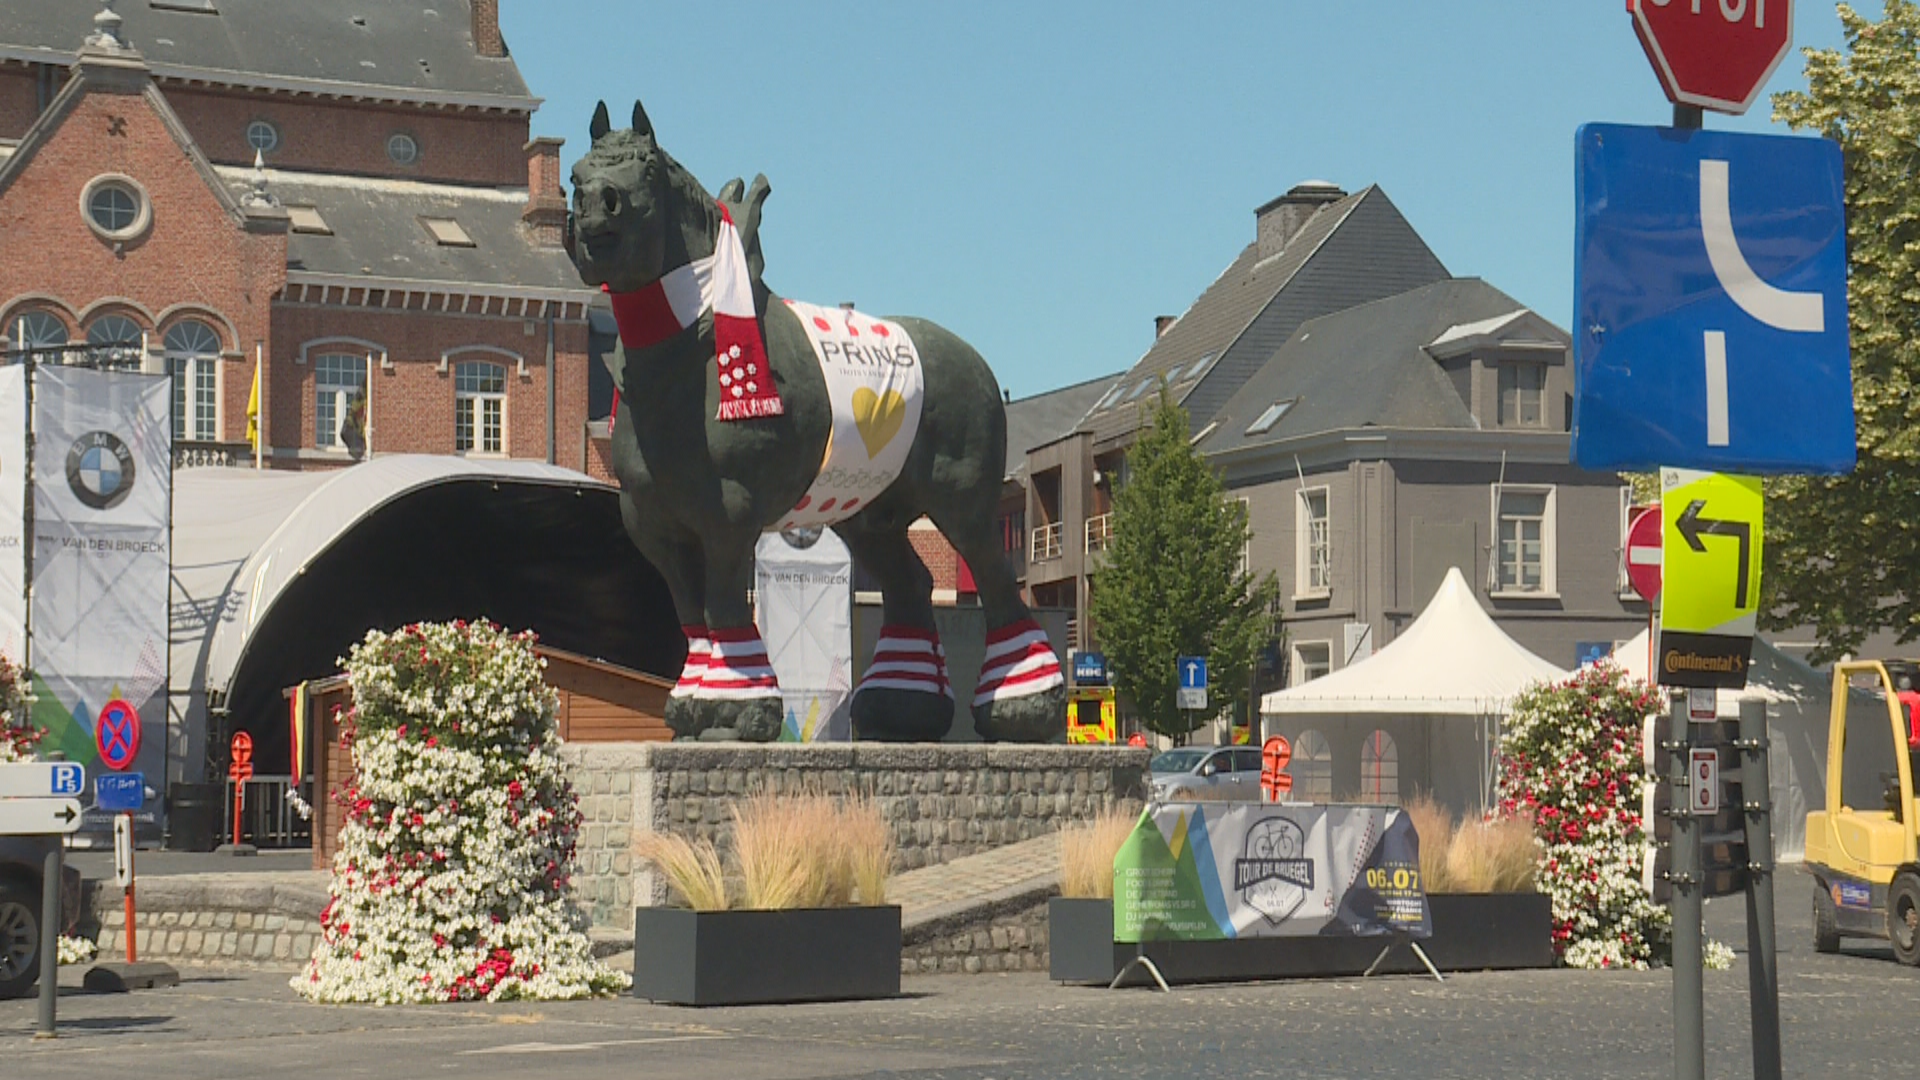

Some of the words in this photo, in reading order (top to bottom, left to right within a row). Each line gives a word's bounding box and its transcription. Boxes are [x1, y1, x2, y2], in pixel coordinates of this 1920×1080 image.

[820, 341, 914, 368] PRINS
[73, 433, 129, 460] BMW
[62, 538, 86, 549] VAN
[90, 538, 113, 550] DEN
[116, 540, 165, 552] BROECK
[775, 573, 792, 583] VAN
[793, 573, 811, 583] DEN
[1077, 667, 1102, 677] KBC
[1665, 649, 1733, 673] Continental
[1238, 861, 1261, 885] TOUR
[1262, 861, 1274, 877] DE
[1275, 861, 1311, 885] BRUEGEL
[1366, 867, 1419, 890] 06.07
